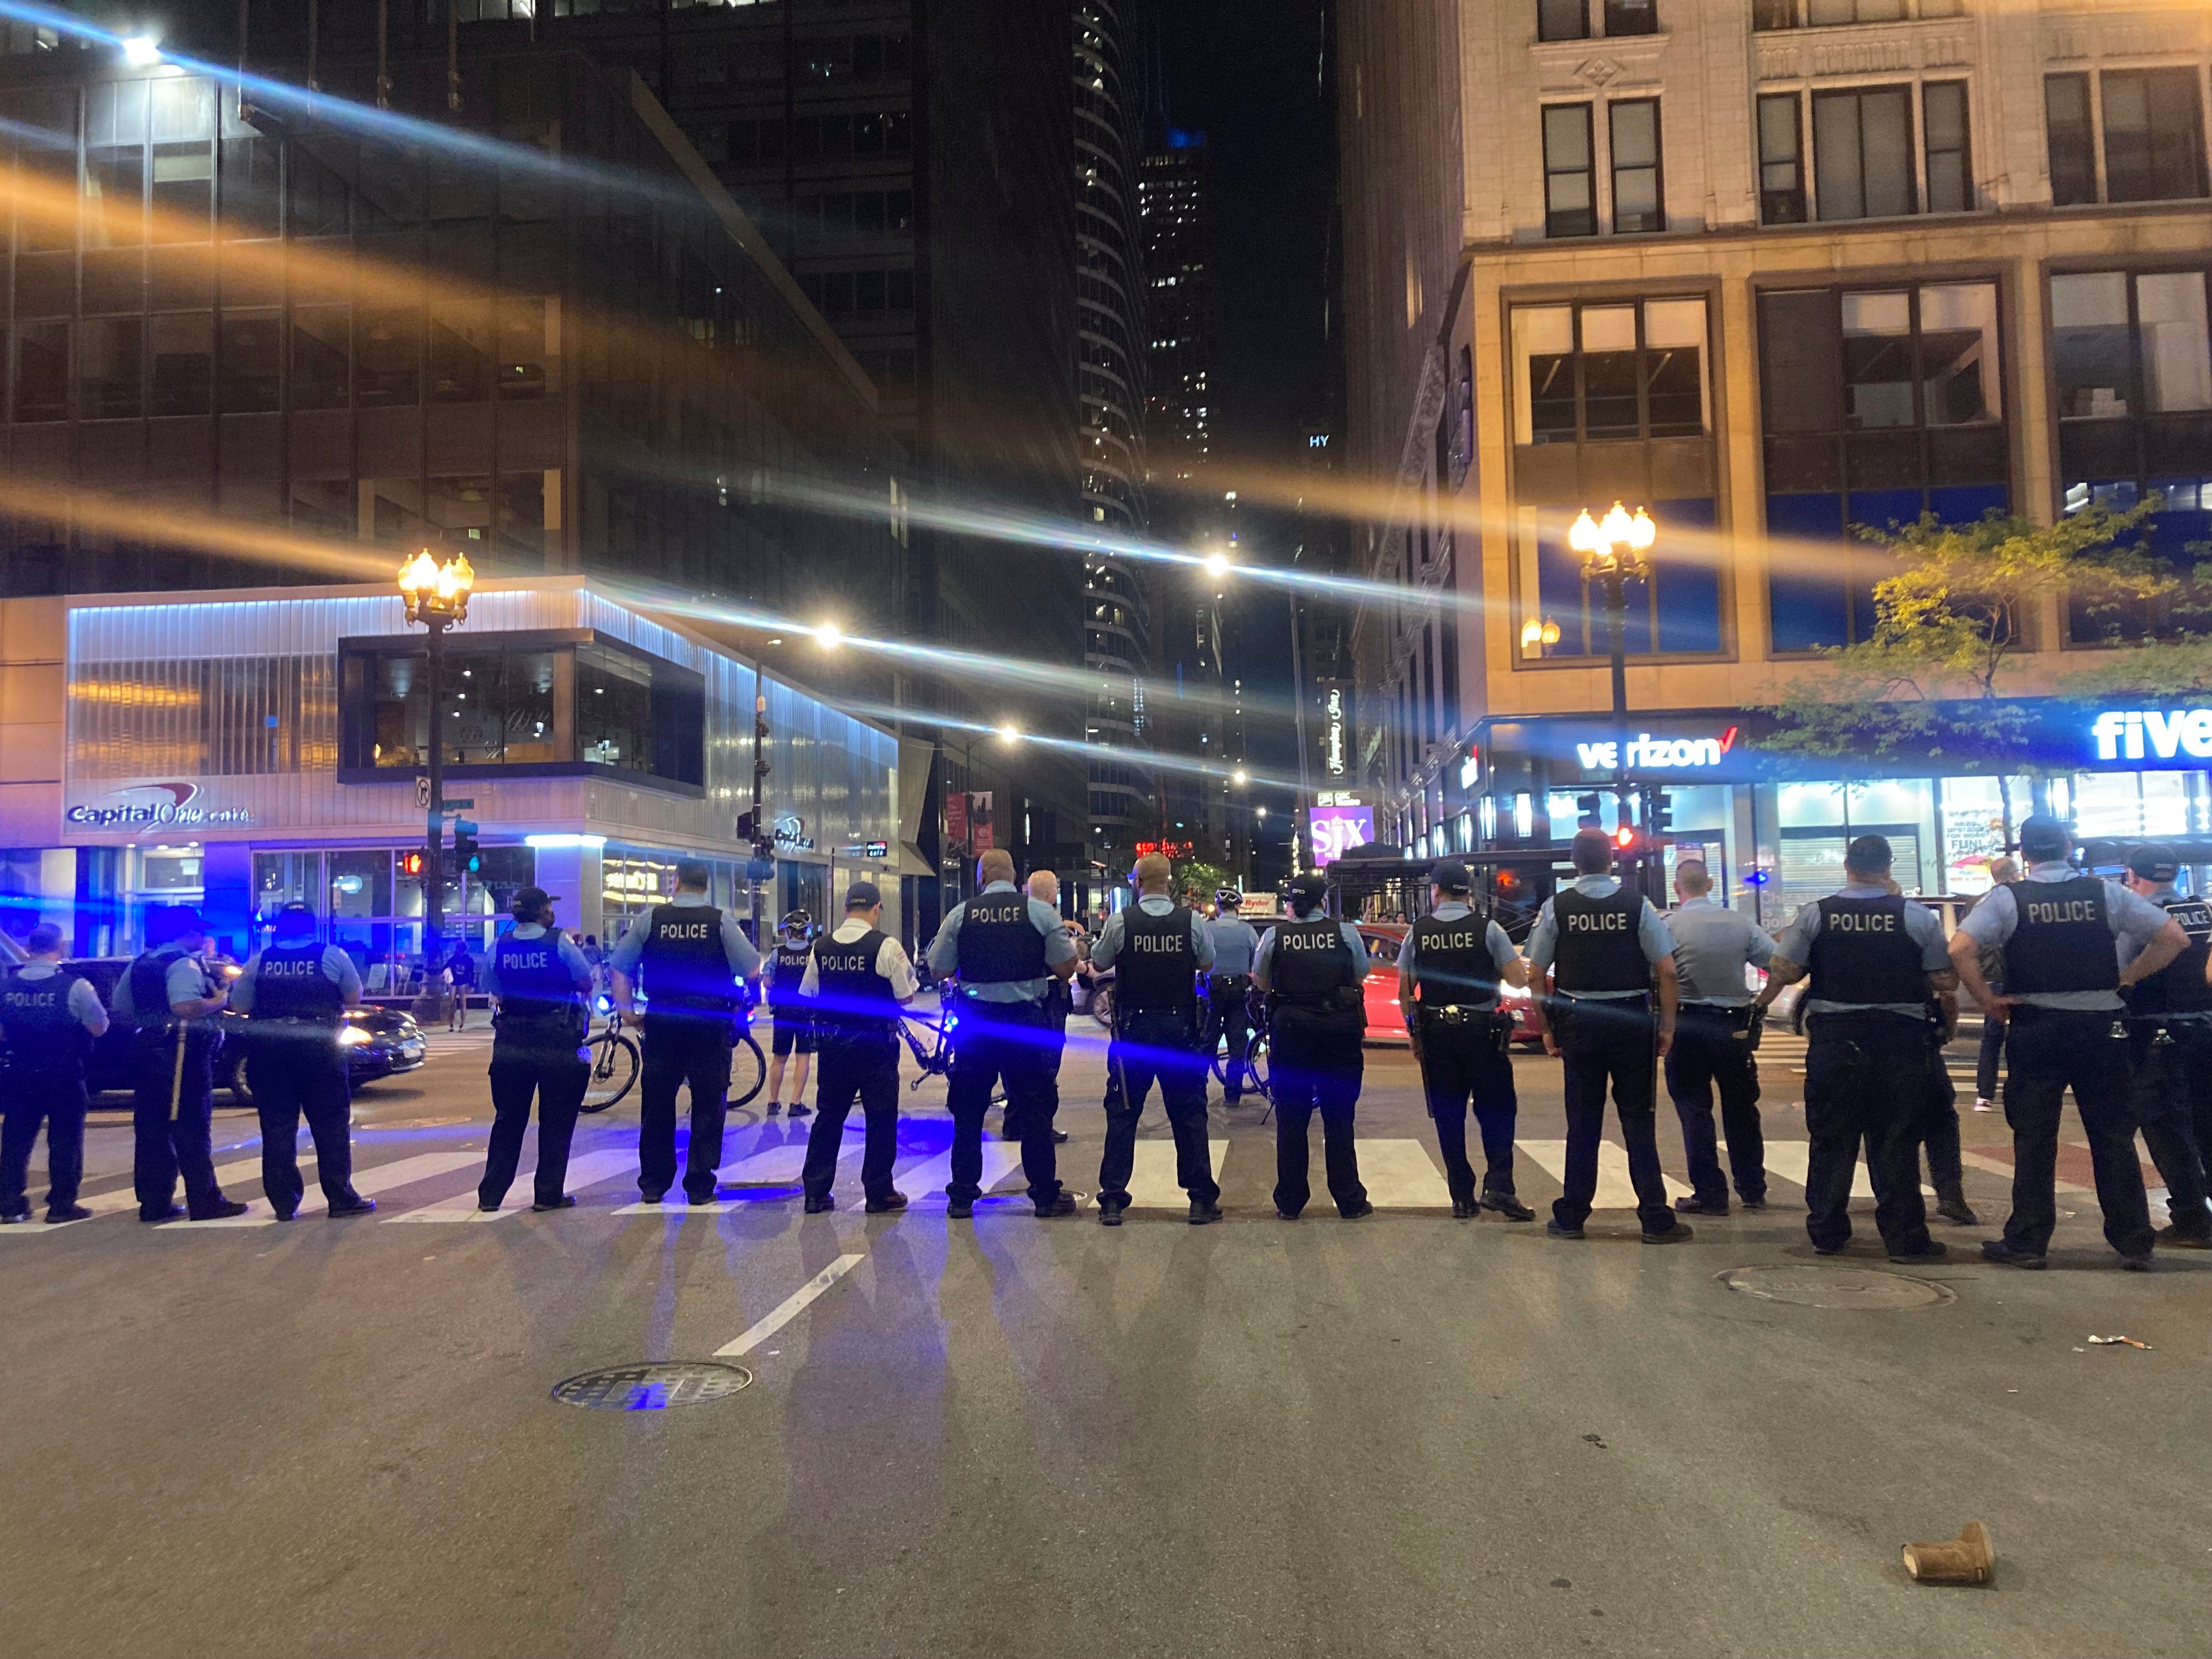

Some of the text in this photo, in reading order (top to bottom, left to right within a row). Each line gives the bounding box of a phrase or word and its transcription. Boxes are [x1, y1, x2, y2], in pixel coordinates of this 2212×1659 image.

[2092, 709, 2212, 759] five
[1577, 733, 1721, 768] verizon
[972, 907, 1020, 923] POLICE
[2029, 900, 2096, 923] POLICE
[2172, 910, 2210, 926] POLICE
[1568, 913, 1627, 931] POLICE
[1830, 913, 1894, 932] POLICE
[661, 924, 708, 939] POLICE
[1134, 935, 1183, 952] POLICE
[1283, 933, 1335, 951] POLICE
[1421, 932, 1474, 951] POLICE
[265, 961, 314, 975] POLICE
[503, 951, 548, 969] POLICE
[822, 955, 865, 971] POLICE
[6, 992, 55, 1007] POLICE
